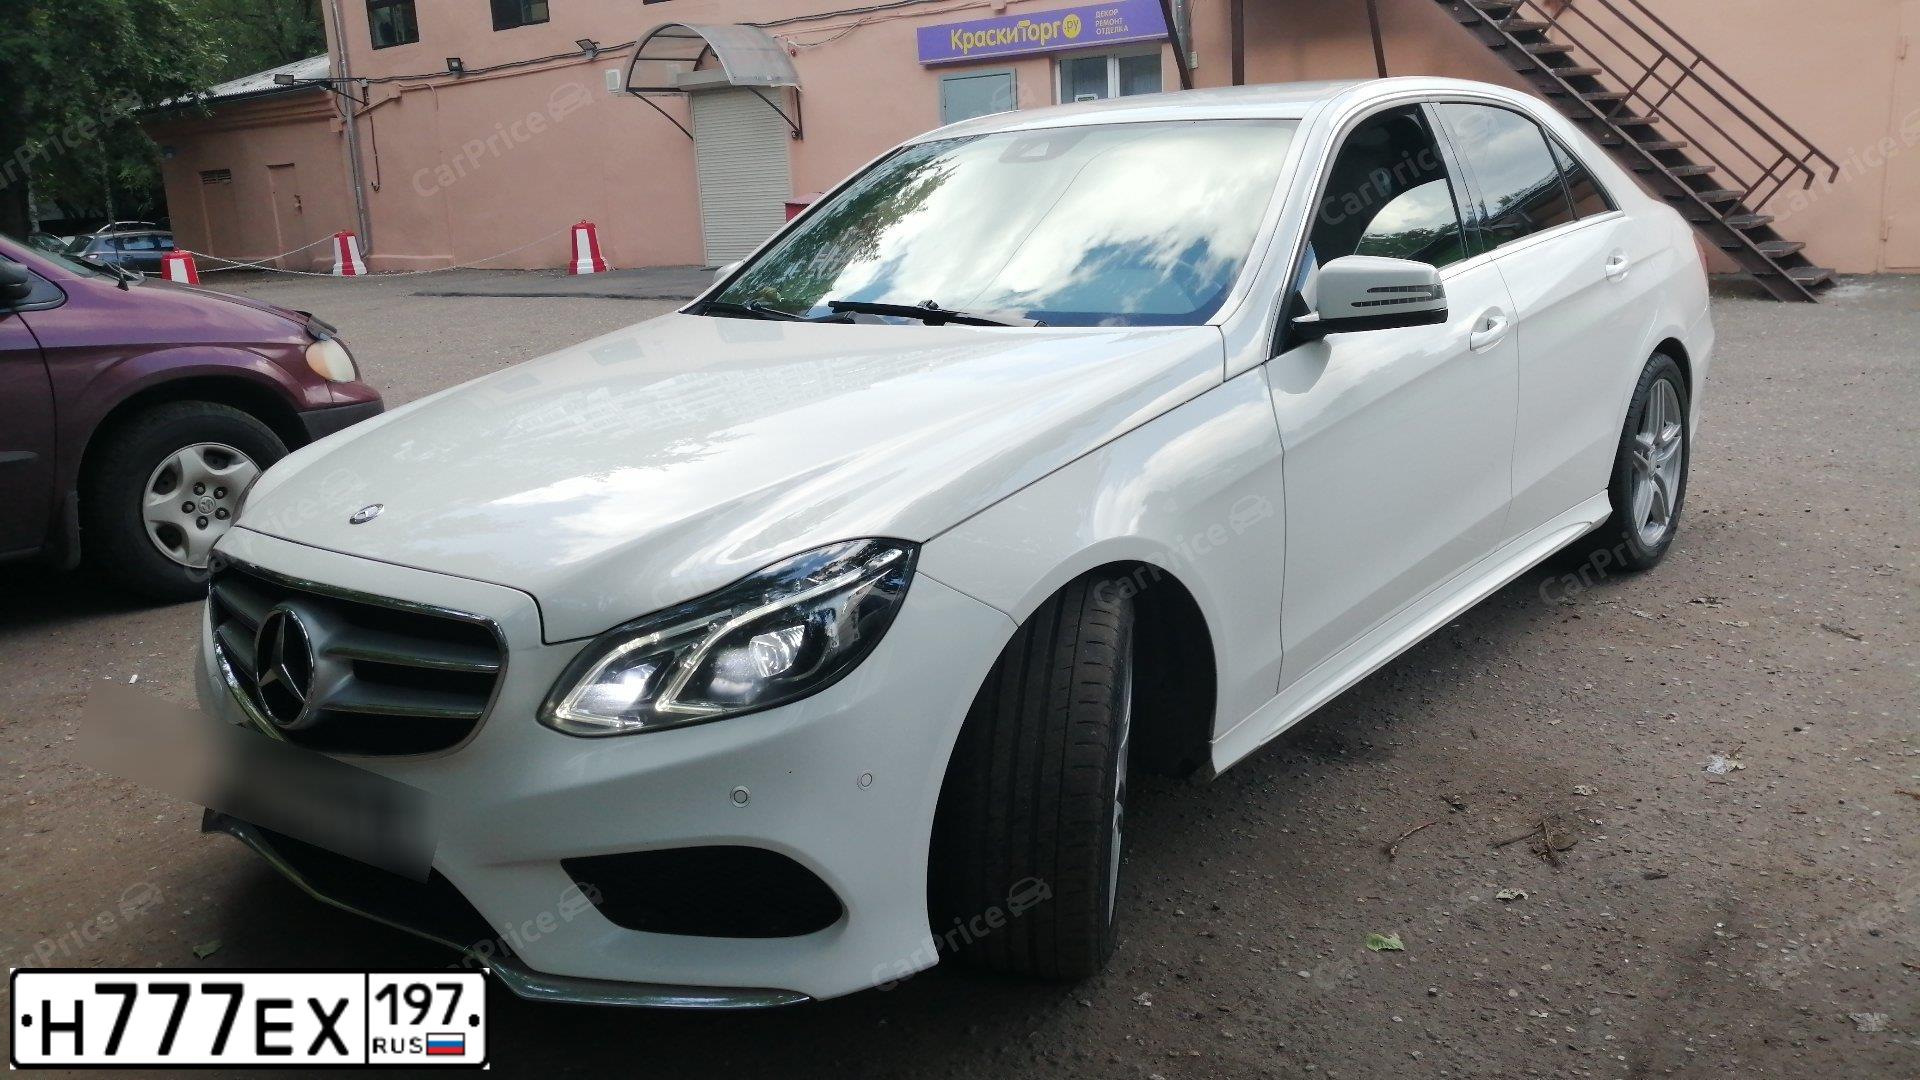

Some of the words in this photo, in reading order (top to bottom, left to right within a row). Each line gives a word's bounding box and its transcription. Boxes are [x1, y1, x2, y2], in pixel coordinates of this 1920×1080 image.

[1095, 8, 1118, 19] ДЕКОР
[1095, 17, 1123, 28] РЕМОНТ
[1095, 25, 1129, 36] ОТДЕЛКА
